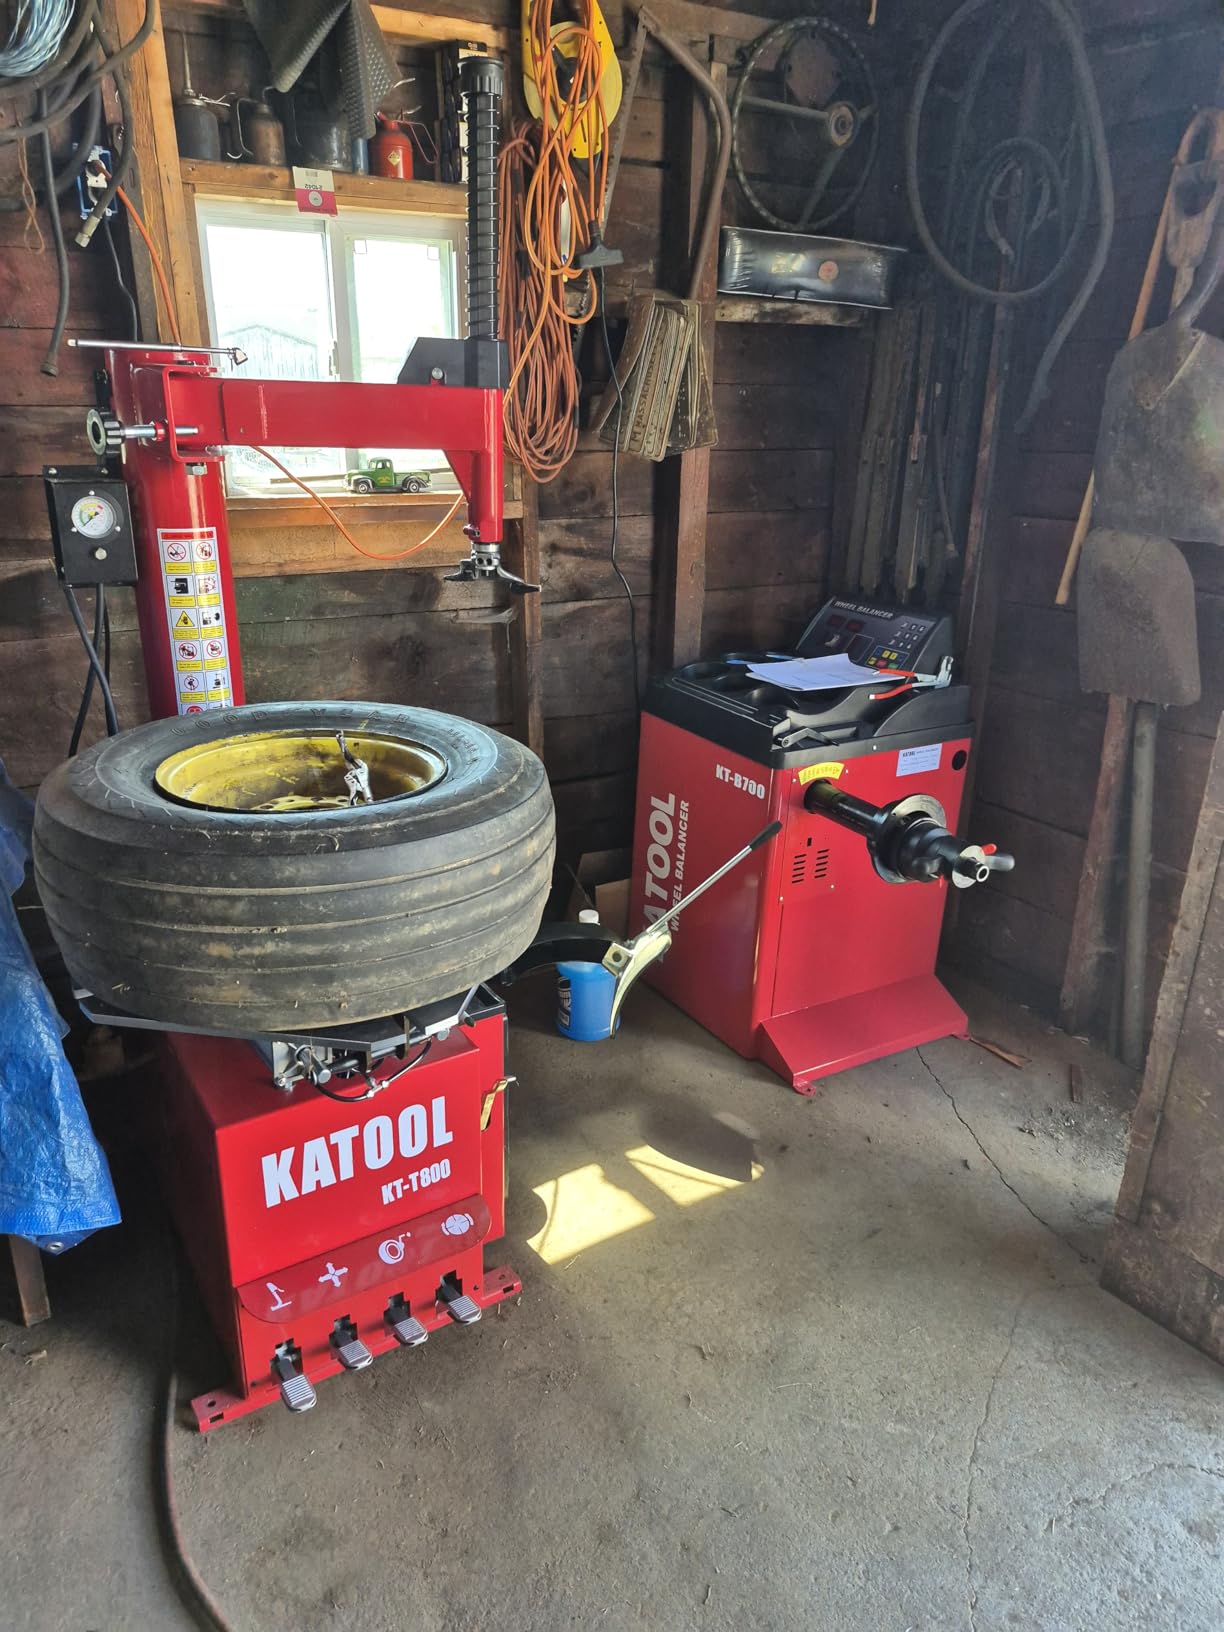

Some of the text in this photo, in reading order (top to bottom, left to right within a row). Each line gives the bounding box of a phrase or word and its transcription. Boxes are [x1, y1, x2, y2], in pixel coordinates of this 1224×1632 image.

[834, 600, 894, 619] WHEEL BALANCER
[715, 764, 766, 800] KT-B700
[643, 792, 676, 926] ATOOL
[674, 800, 690, 880] BALANCER
[261, 1095, 454, 1209] KATOOL
[381, 1158, 451, 1206] KT-T800
